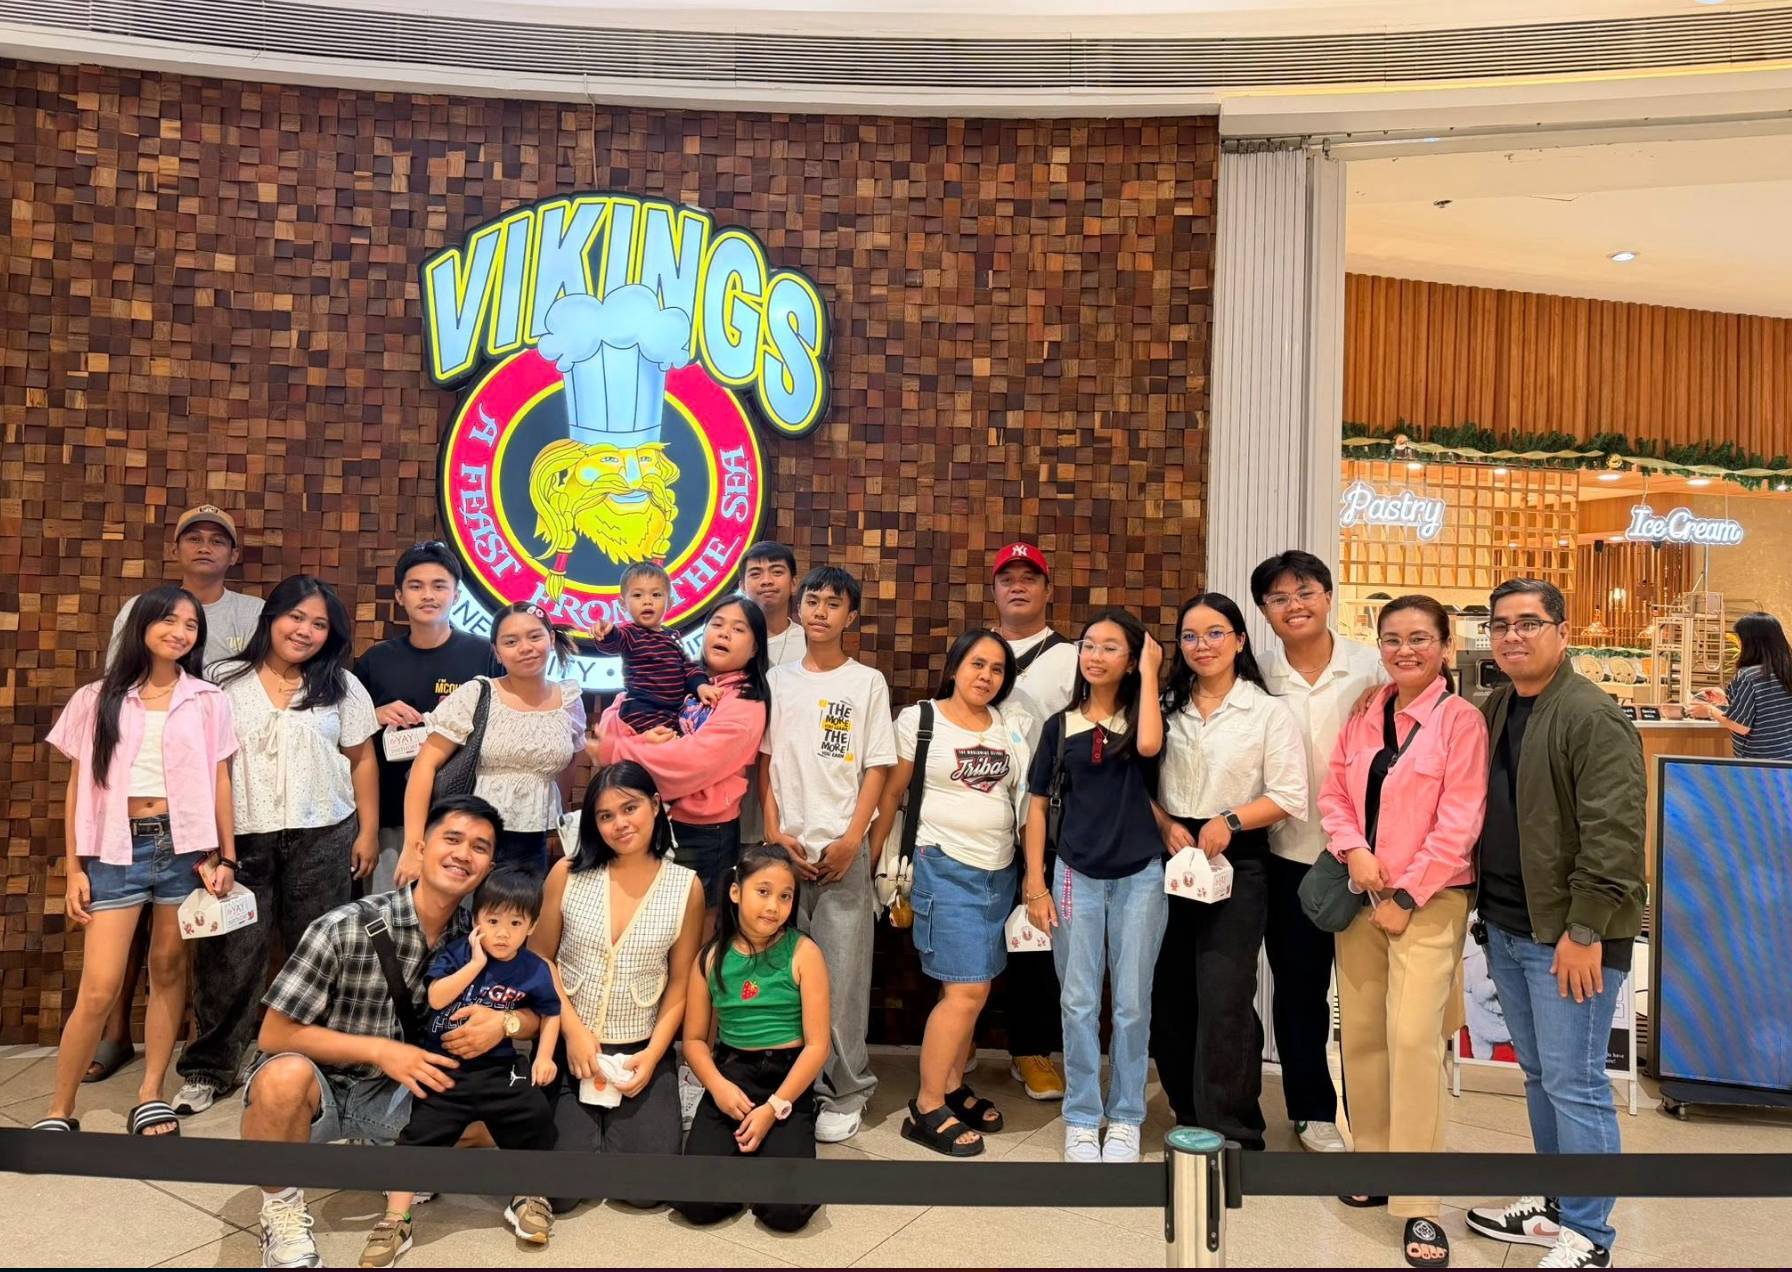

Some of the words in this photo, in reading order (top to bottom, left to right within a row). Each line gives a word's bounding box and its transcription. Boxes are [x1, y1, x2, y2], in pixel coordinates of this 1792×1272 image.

[424, 197, 822, 432] VIKINGS
[469, 402, 499, 447] A
[719, 444, 754, 523] SEA
[461, 463, 523, 578] FEAST
[1342, 483, 1443, 538] Pastry
[1628, 508, 1665, 537] Ice
[1668, 511, 1741, 541] Cream
[1012, 544, 1027, 557] NY
[825, 714, 850, 728] MORE
[828, 702, 852, 718] THE
[821, 741, 846, 754] MORE
[825, 728, 847, 744] THE
[950, 754, 1010, 780] Tribal
